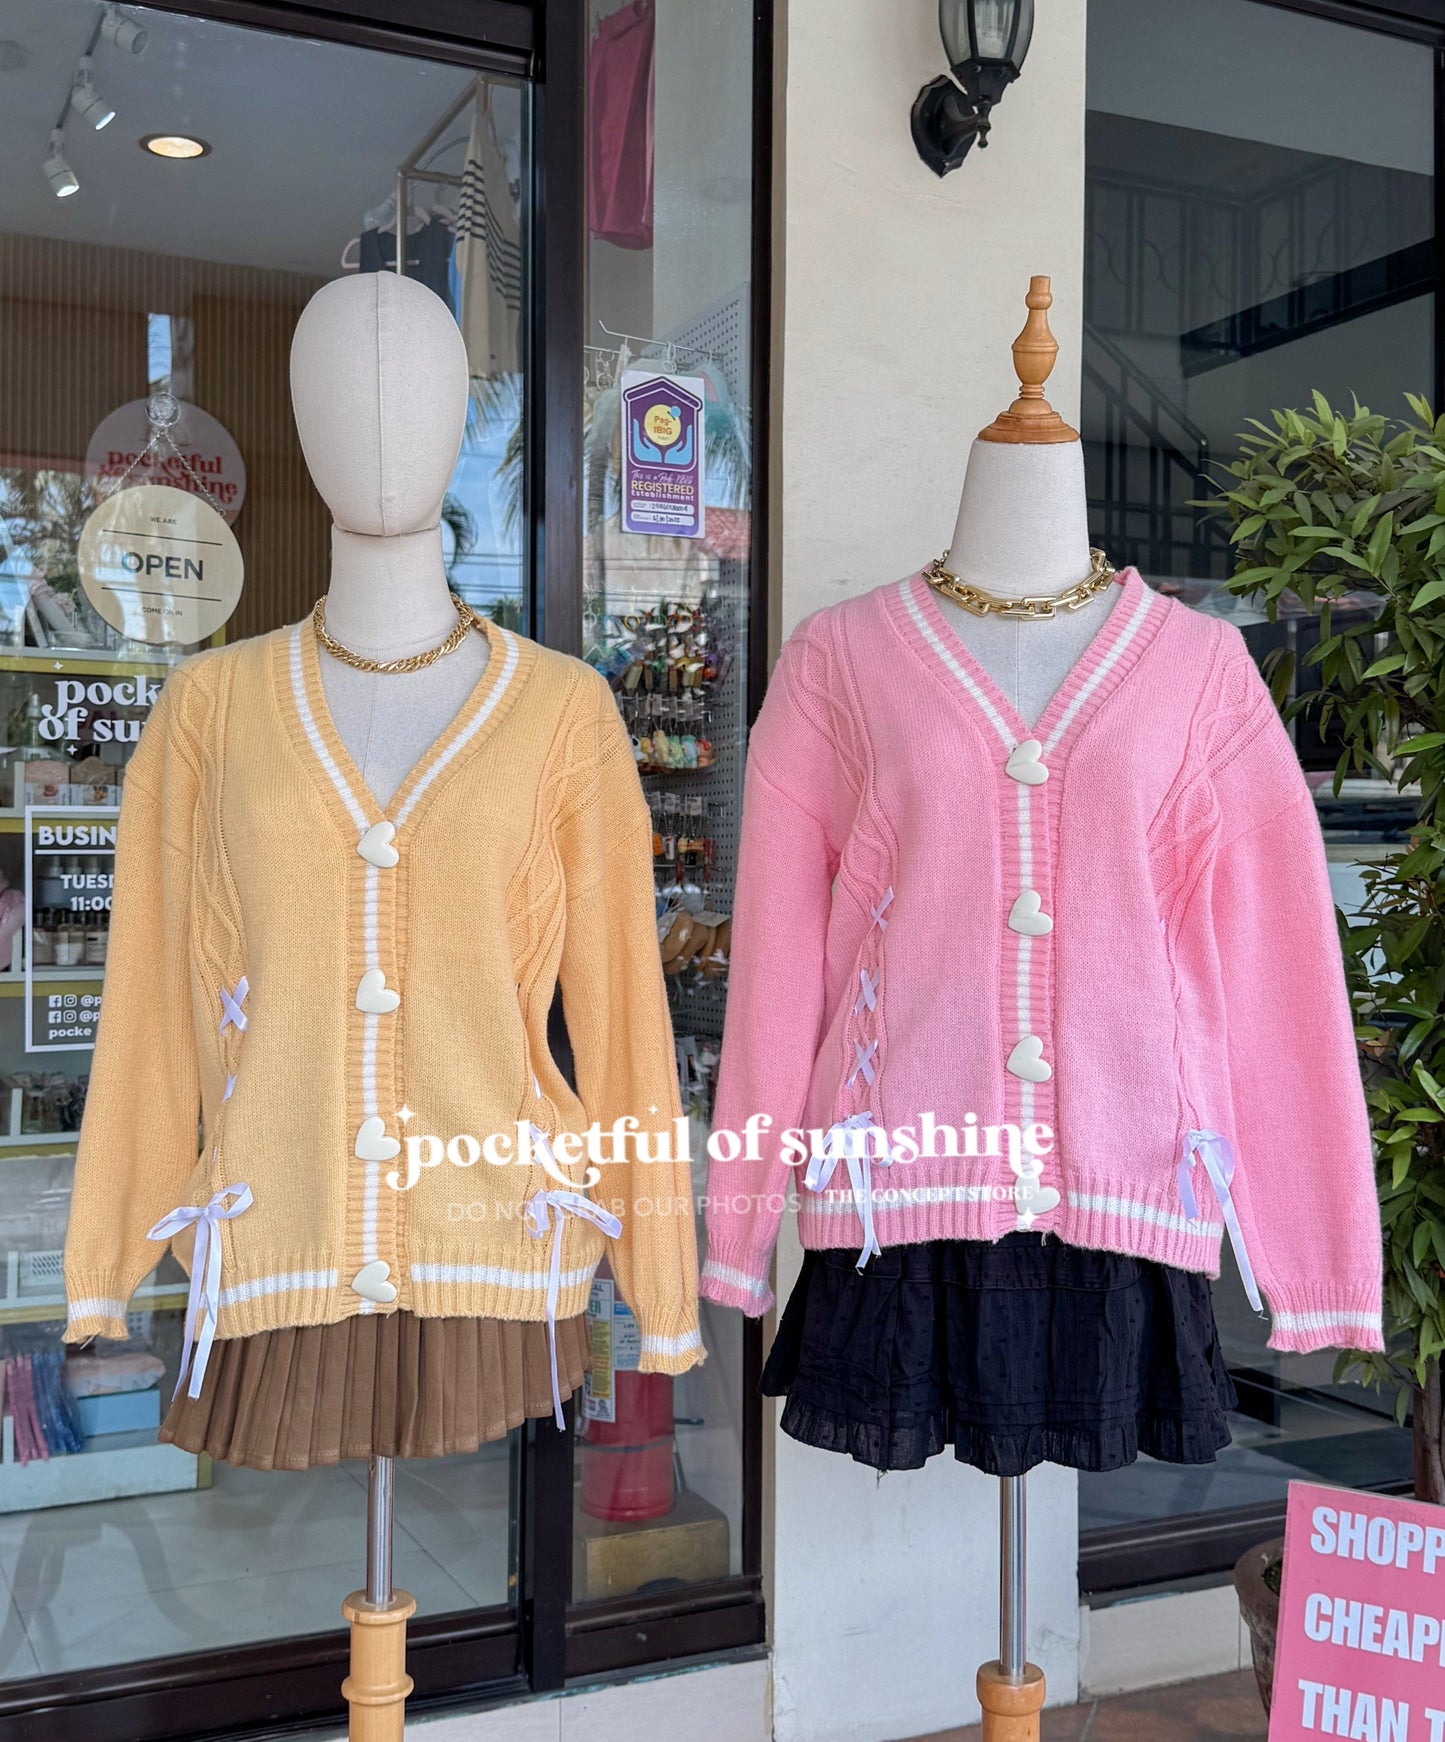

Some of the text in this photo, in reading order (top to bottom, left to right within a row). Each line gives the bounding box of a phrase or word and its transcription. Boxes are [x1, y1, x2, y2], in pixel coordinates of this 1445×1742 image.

[631, 480, 694, 495] REGISTERED
[631, 489, 694, 502] Establishment
[121, 551, 204, 582] OPEN
[38, 706, 89, 741] of
[93, 719, 146, 742] su
[1310, 1506, 1445, 1574] SHOPP
[1304, 1592, 1445, 1668] CHEAP
[1298, 1679, 1410, 1742] THAN
